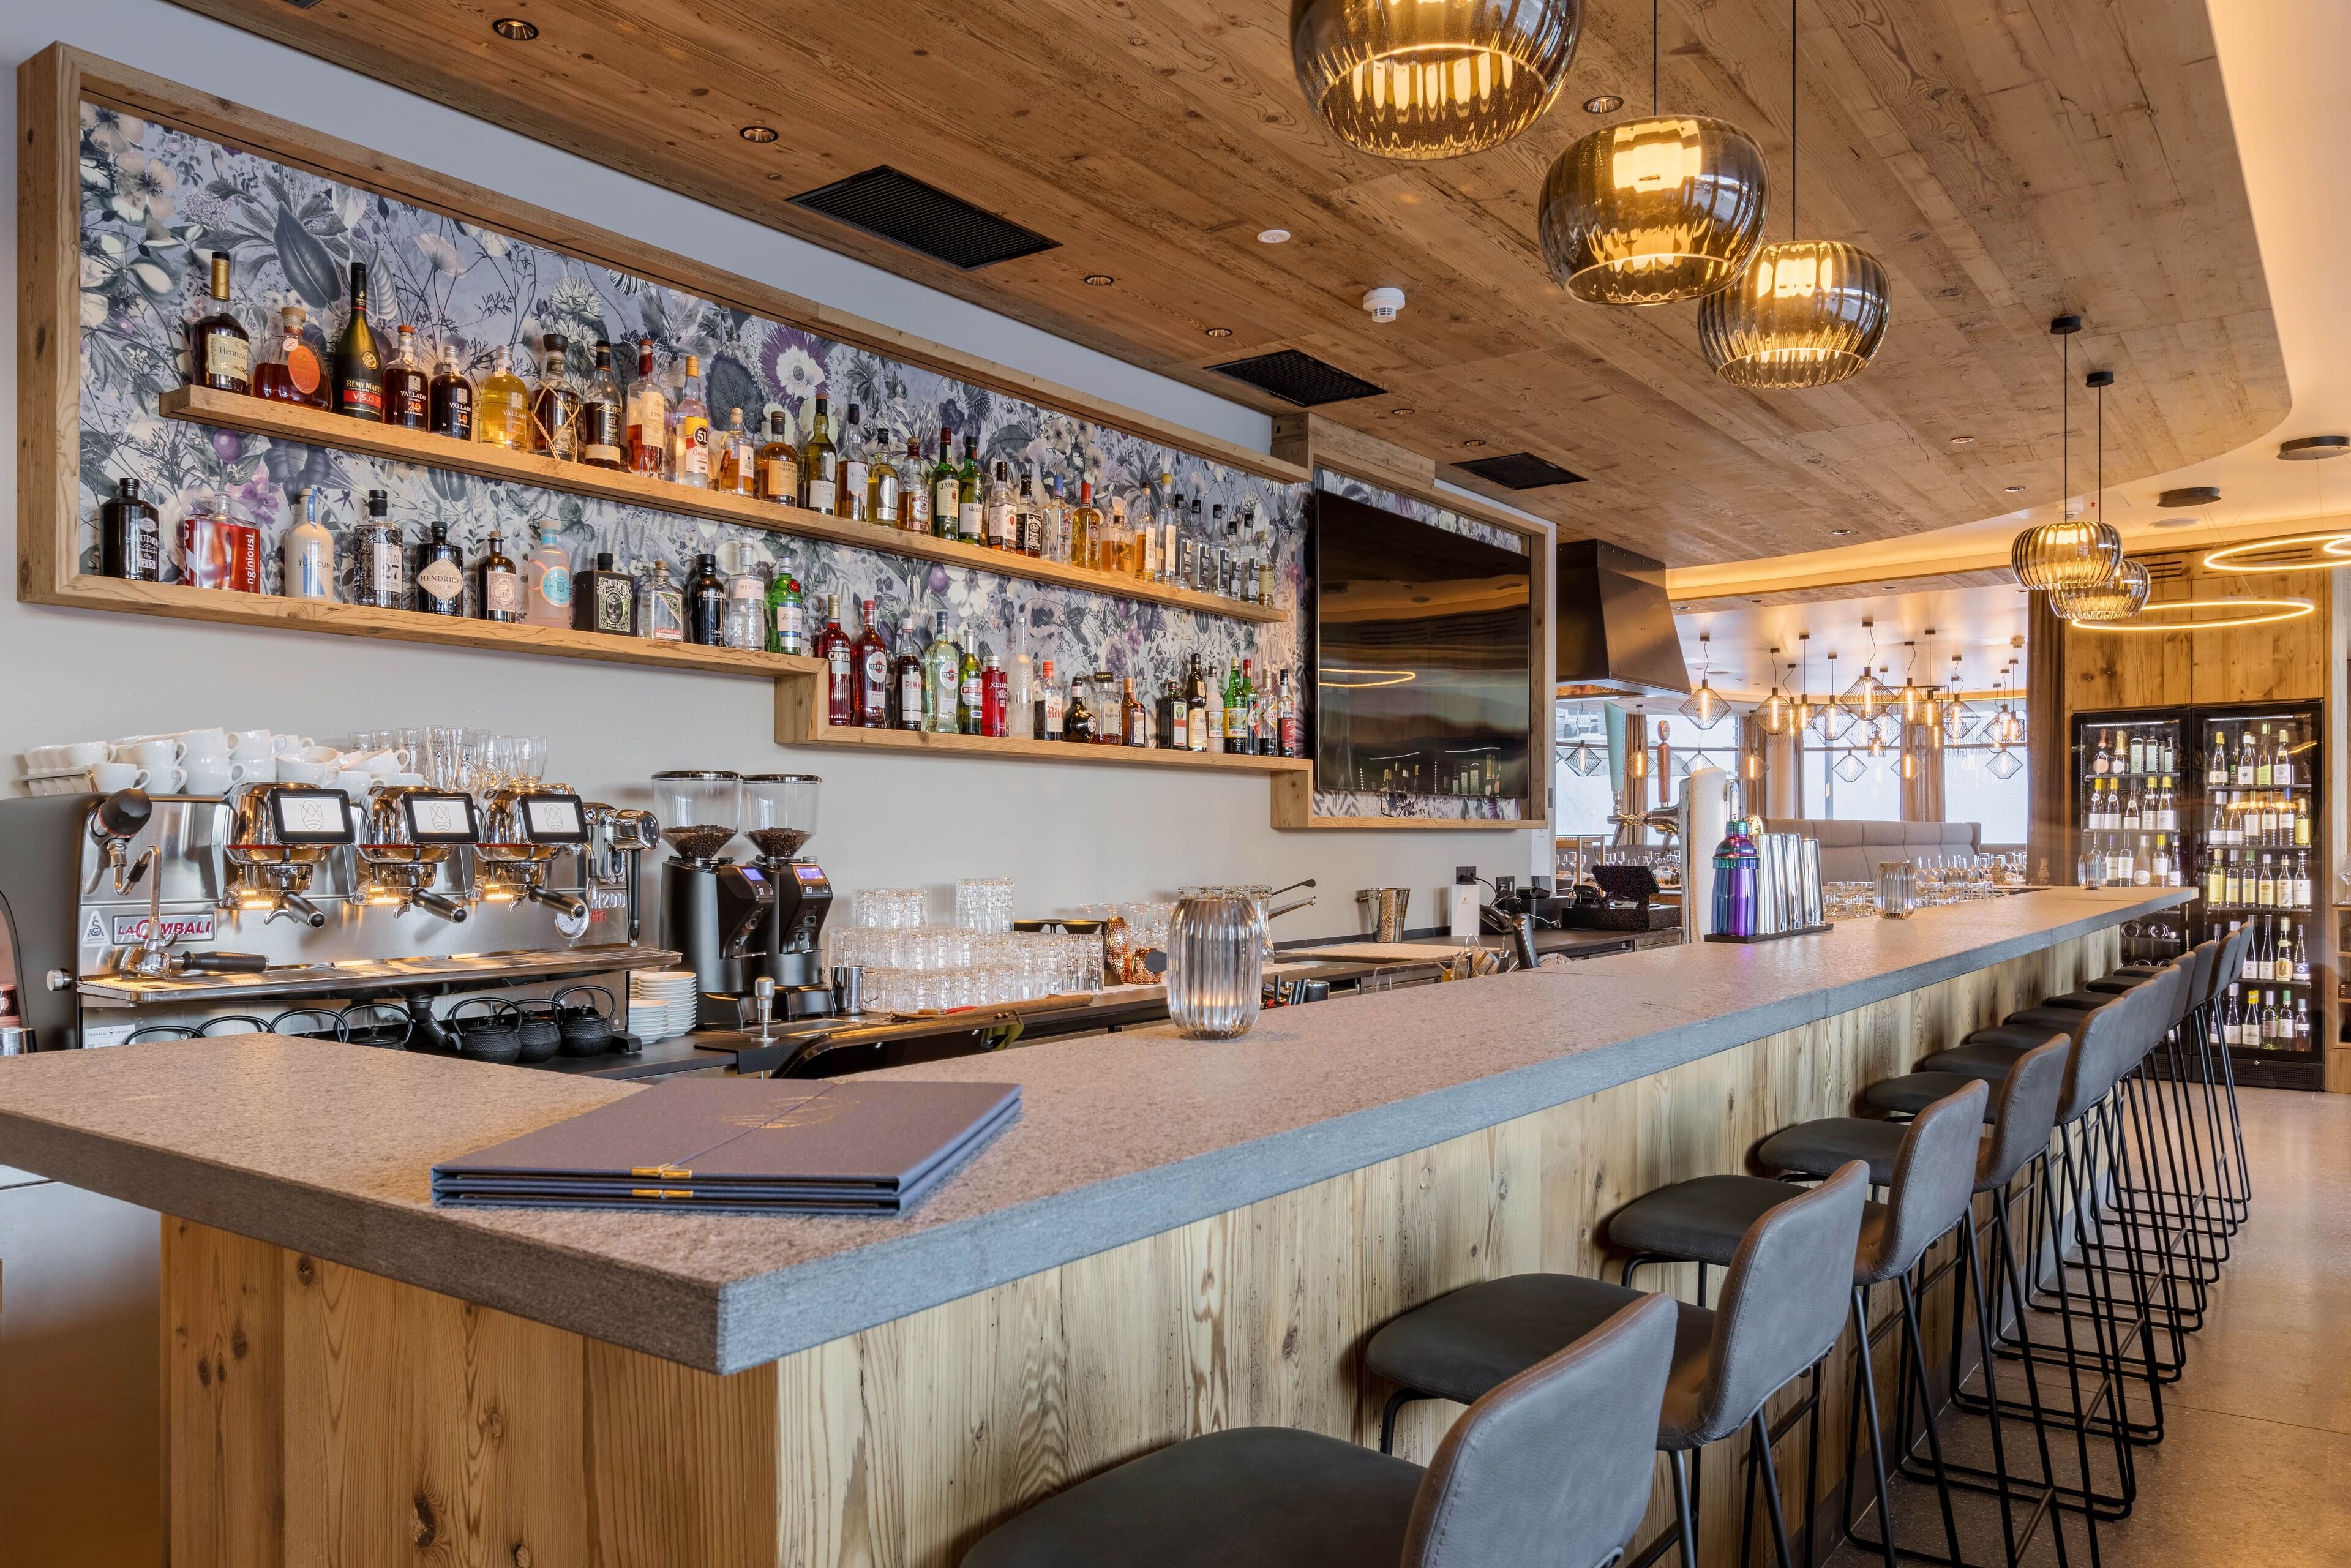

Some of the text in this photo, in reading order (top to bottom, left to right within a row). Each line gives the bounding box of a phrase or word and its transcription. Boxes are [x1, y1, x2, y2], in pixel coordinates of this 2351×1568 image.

[347, 380, 365, 388] RÉMY
[400, 391, 426, 400] VALLADO
[449, 402, 471, 413] VALLADO
[503, 410, 527, 420] VALLADO
[697, 430, 707, 443] 51
[245, 534, 257, 585] nginious!
[298, 560, 331, 569] TUCUM
[383, 565, 400, 580] 27
[136, 919, 212, 939] CMBALI
